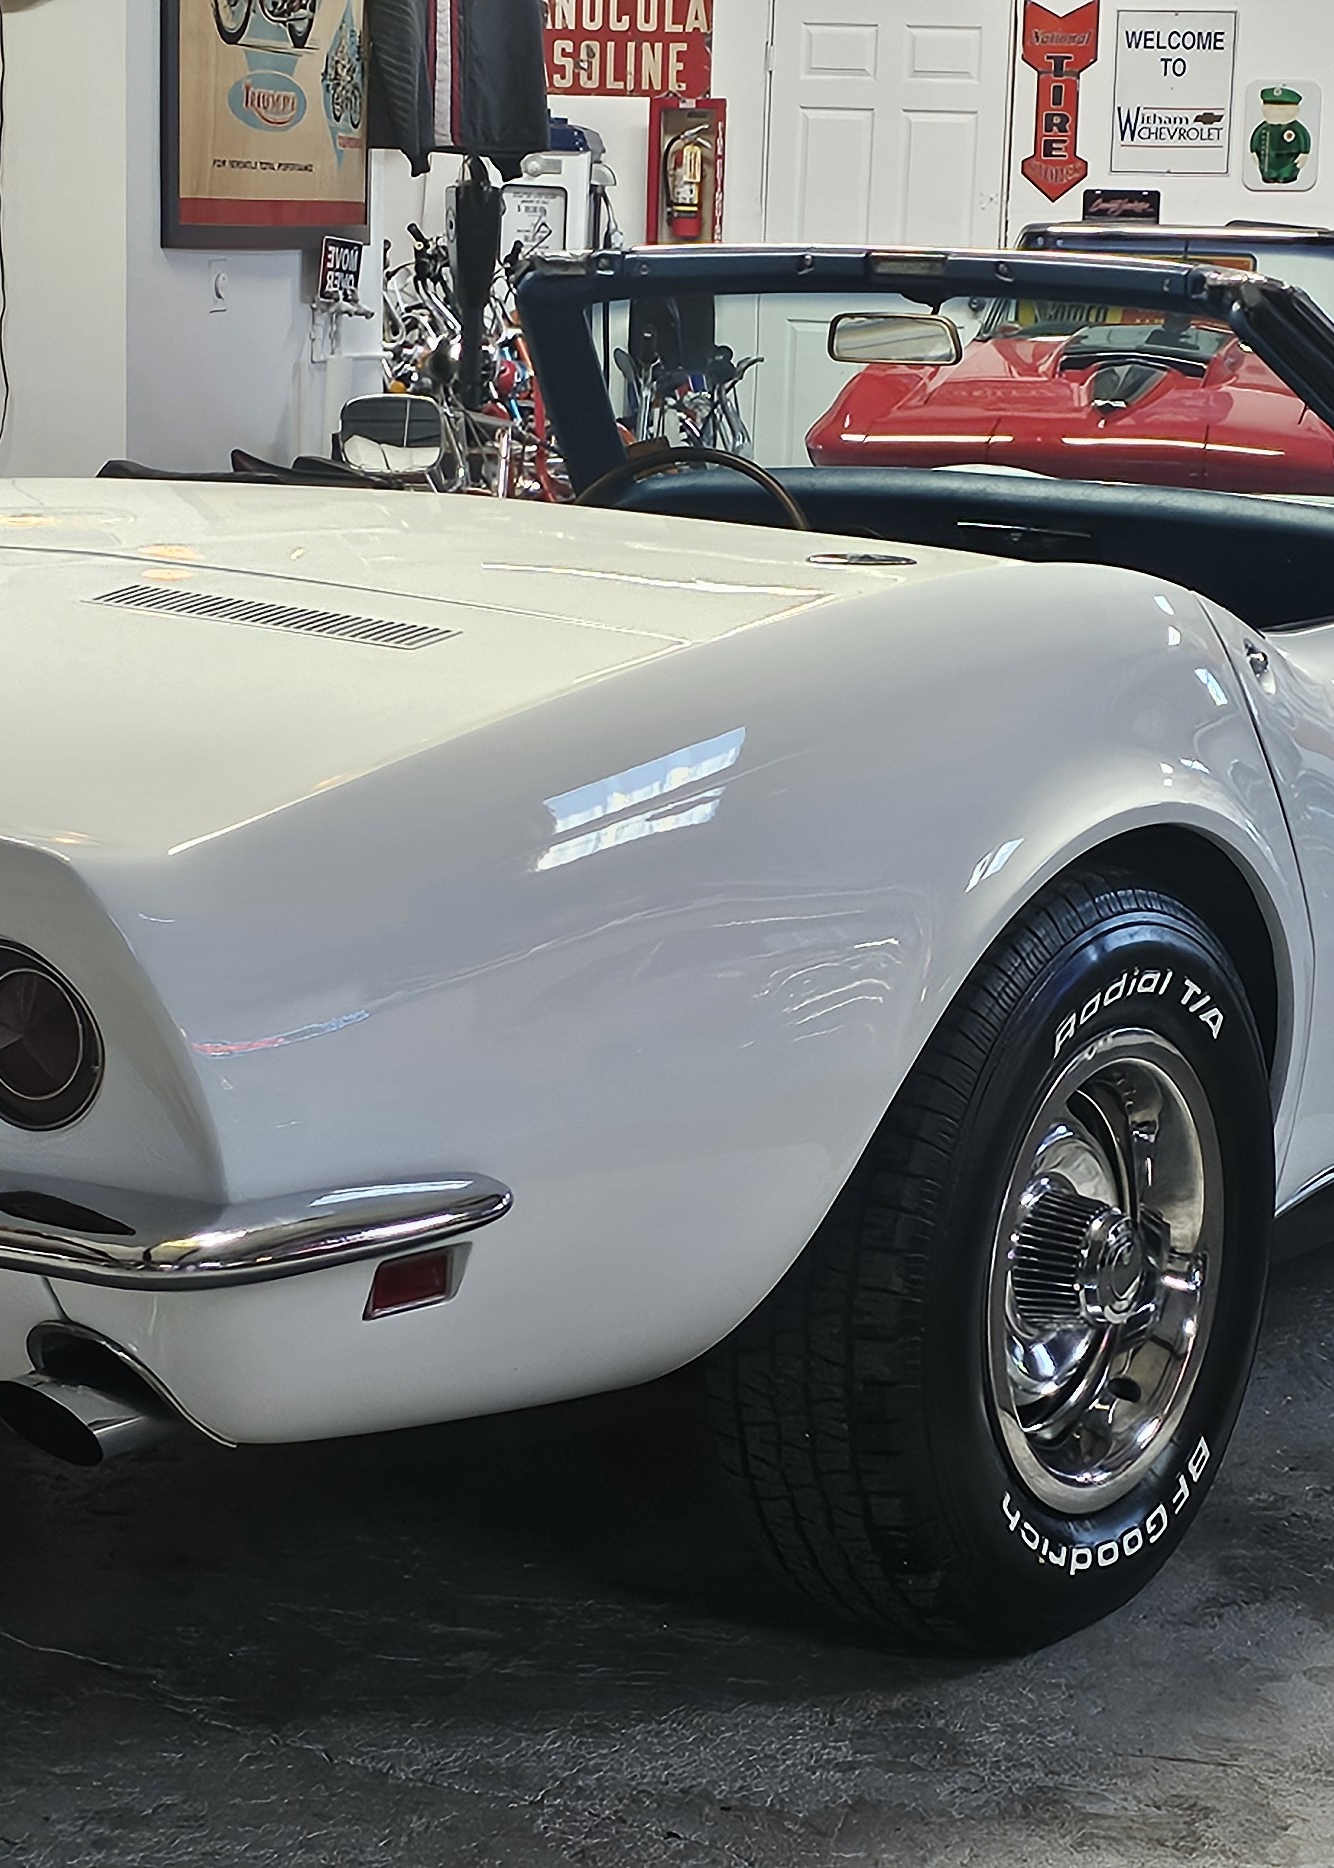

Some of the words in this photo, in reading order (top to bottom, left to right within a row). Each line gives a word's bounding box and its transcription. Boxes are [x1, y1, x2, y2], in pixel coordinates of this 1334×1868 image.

[1032, 29, 1092, 46] National
[1125, 30, 1225, 50] WELCOME
[545, 39, 688, 91] SOLINE
[1160, 57, 1187, 77] TO
[1042, 54, 1074, 159] TIRE
[1117, 106, 1189, 141] Witham
[1138, 127, 1224, 141] CHEVROLET
[1053, 967, 1173, 1060] Radial
[1180, 977, 1225, 1040] T/A
[1001, 1435, 1211, 1576] BFGoodrich
